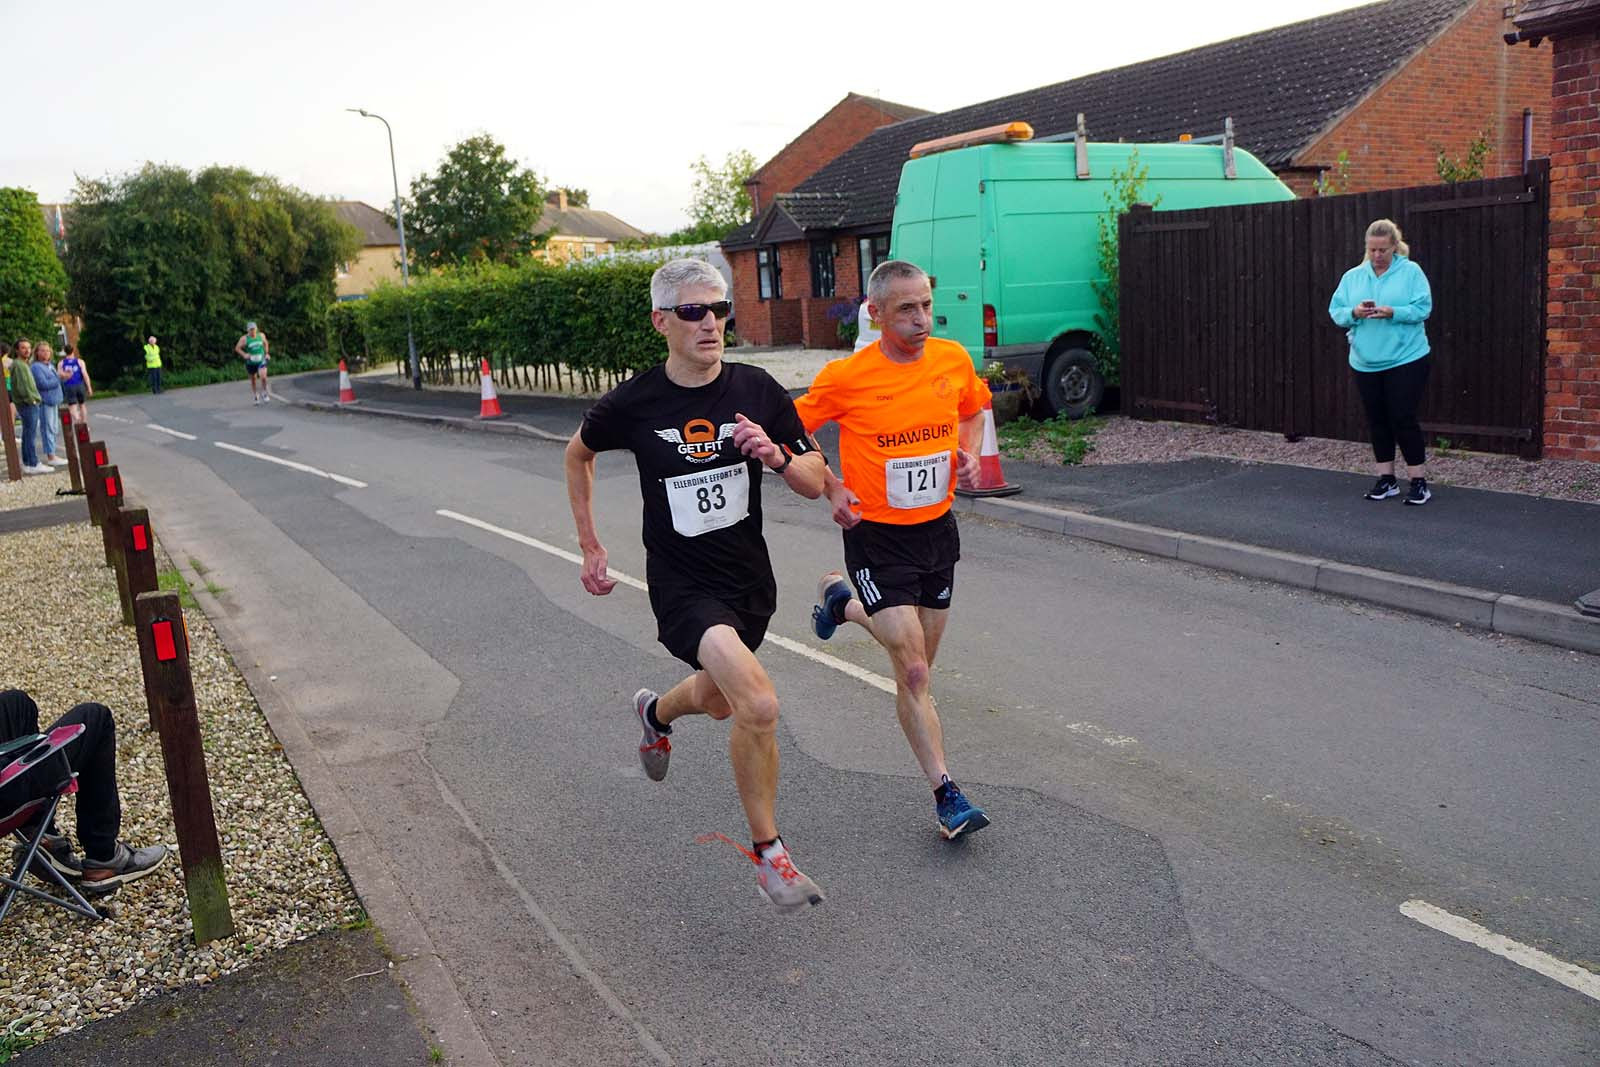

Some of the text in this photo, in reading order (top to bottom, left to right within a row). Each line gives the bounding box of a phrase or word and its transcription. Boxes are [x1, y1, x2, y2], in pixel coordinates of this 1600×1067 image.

[877, 422, 954, 448] SHAWBURY
[677, 440, 724, 454] GET FIT
[892, 460, 923, 470] ELLERDINE
[923, 457, 941, 467] EFFORT
[673, 475, 709, 489] ELLERDINE
[709, 470, 733, 483] EFFORT
[907, 466, 936, 493] 121
[696, 483, 727, 514] 83
